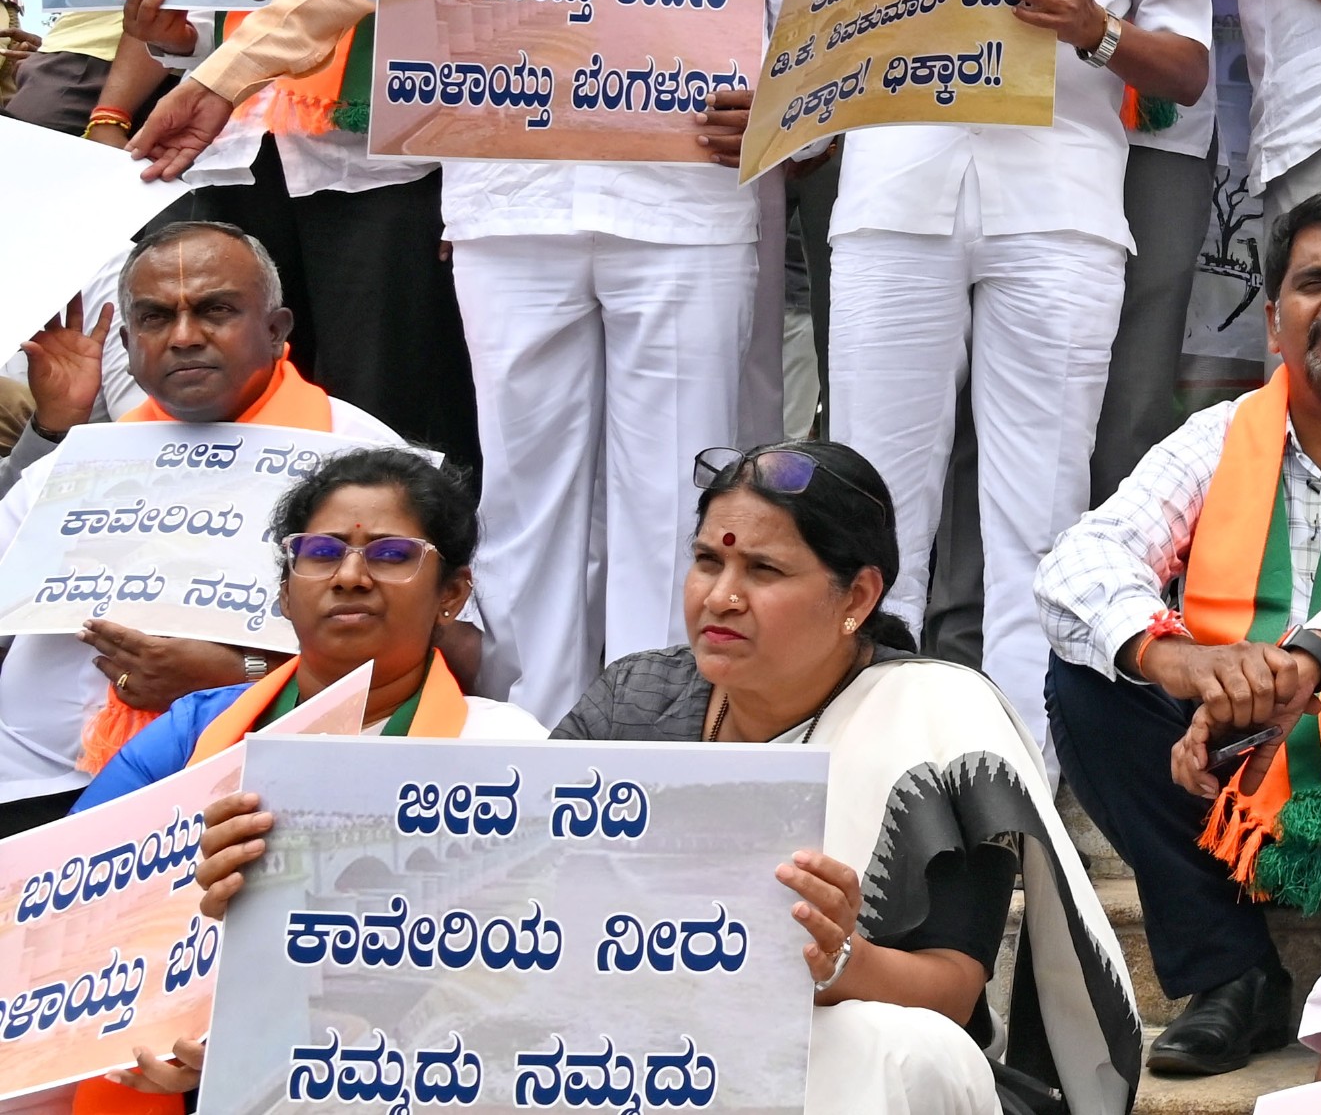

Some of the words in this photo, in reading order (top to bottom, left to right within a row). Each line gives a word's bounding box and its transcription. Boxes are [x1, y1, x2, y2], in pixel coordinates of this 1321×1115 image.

[386, 51, 555, 130] ಹಾಳಾಯ್ತು
[781, 57, 872, 131] ಧಿಕ್ಕಾರ!
[882, 40, 1003, 105] ಧಿಕ್ಕಾರ!!
[155, 437, 244, 469] ಜೀವ
[60, 499, 244, 537] ಕಾವೇರಿಯ
[34, 568, 166, 618] ನಮ್ಮದು
[396, 766, 521, 838] ಜೀವ
[550, 768, 650, 839] ನದಿ
[285, 895, 562, 971] ಕಾವೇರಿಯ
[597, 901, 749, 972] ನೀರು
[0, 948, 145, 1040] ಳಾಯ್ತು
[288, 1028, 482, 1115] ನಮ್ಮದು
[514, 1034, 717, 1115] ನಮ್ಮದು
